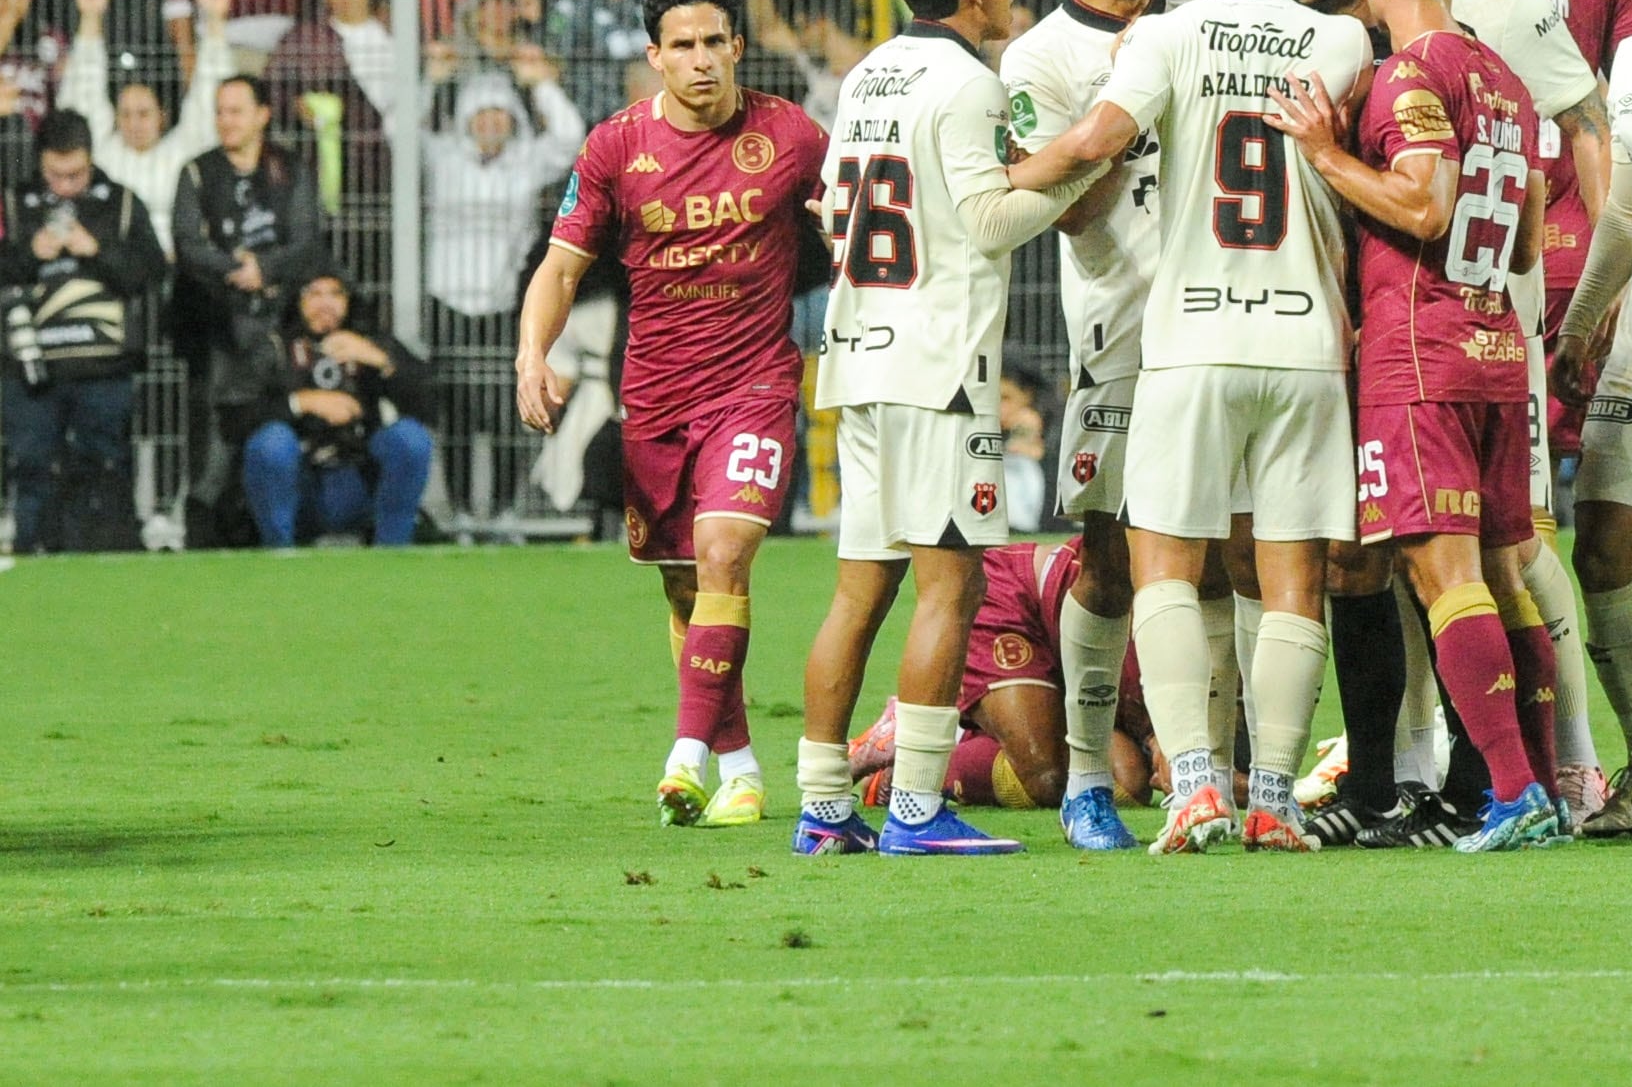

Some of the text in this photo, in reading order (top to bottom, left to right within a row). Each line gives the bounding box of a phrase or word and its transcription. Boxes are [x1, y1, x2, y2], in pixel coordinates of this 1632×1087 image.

[1201, 20, 1315, 61] Tropical
[1213, 110, 1290, 250] 9
[685, 188, 765, 230] BAC
[650, 241, 760, 268] LIBERTY
[1183, 287, 1313, 316] BYD
[1475, 329, 1515, 347] STAR
[1483, 344, 1525, 362] CARS
[1087, 410, 1131, 429] ABU
[726, 433, 783, 490] 23
[1434, 488, 1480, 517] RC
[690, 655, 732, 674] SAP
